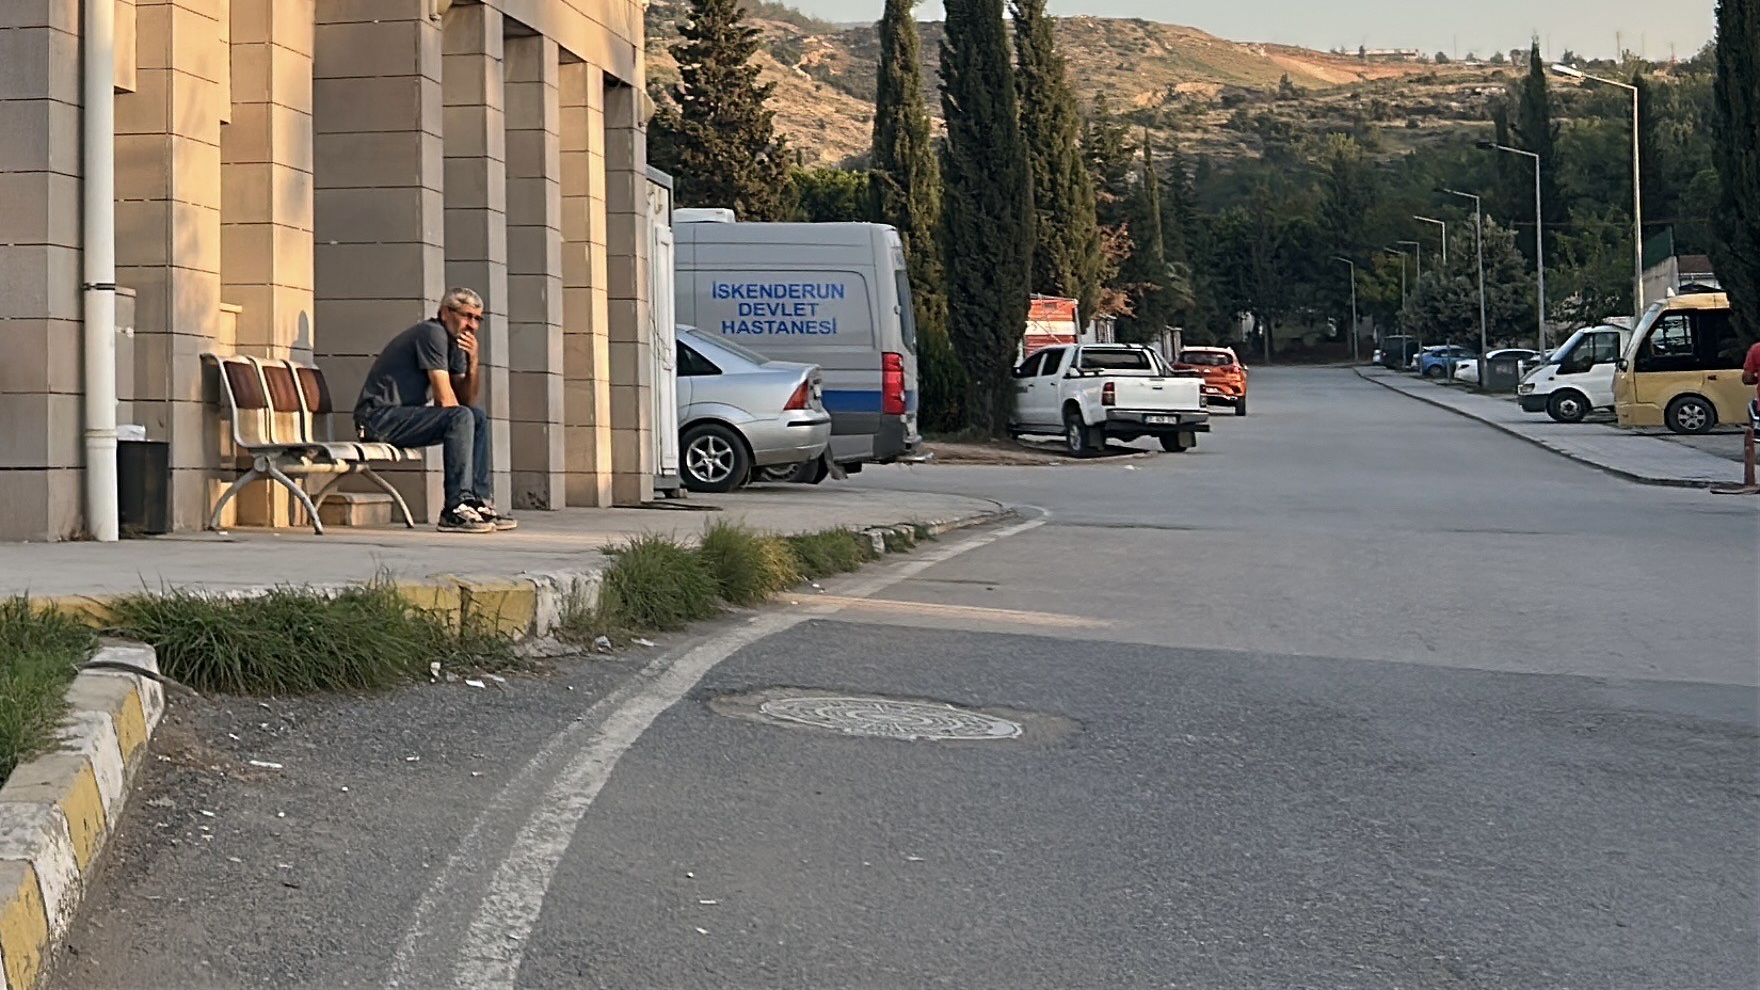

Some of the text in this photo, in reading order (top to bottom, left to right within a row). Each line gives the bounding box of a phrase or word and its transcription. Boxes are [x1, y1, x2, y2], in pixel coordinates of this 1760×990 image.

[711, 280, 845, 300] İSKENDERUN
[739, 303, 819, 317] DEVLET
[721, 317, 837, 335] HASTANESİ
